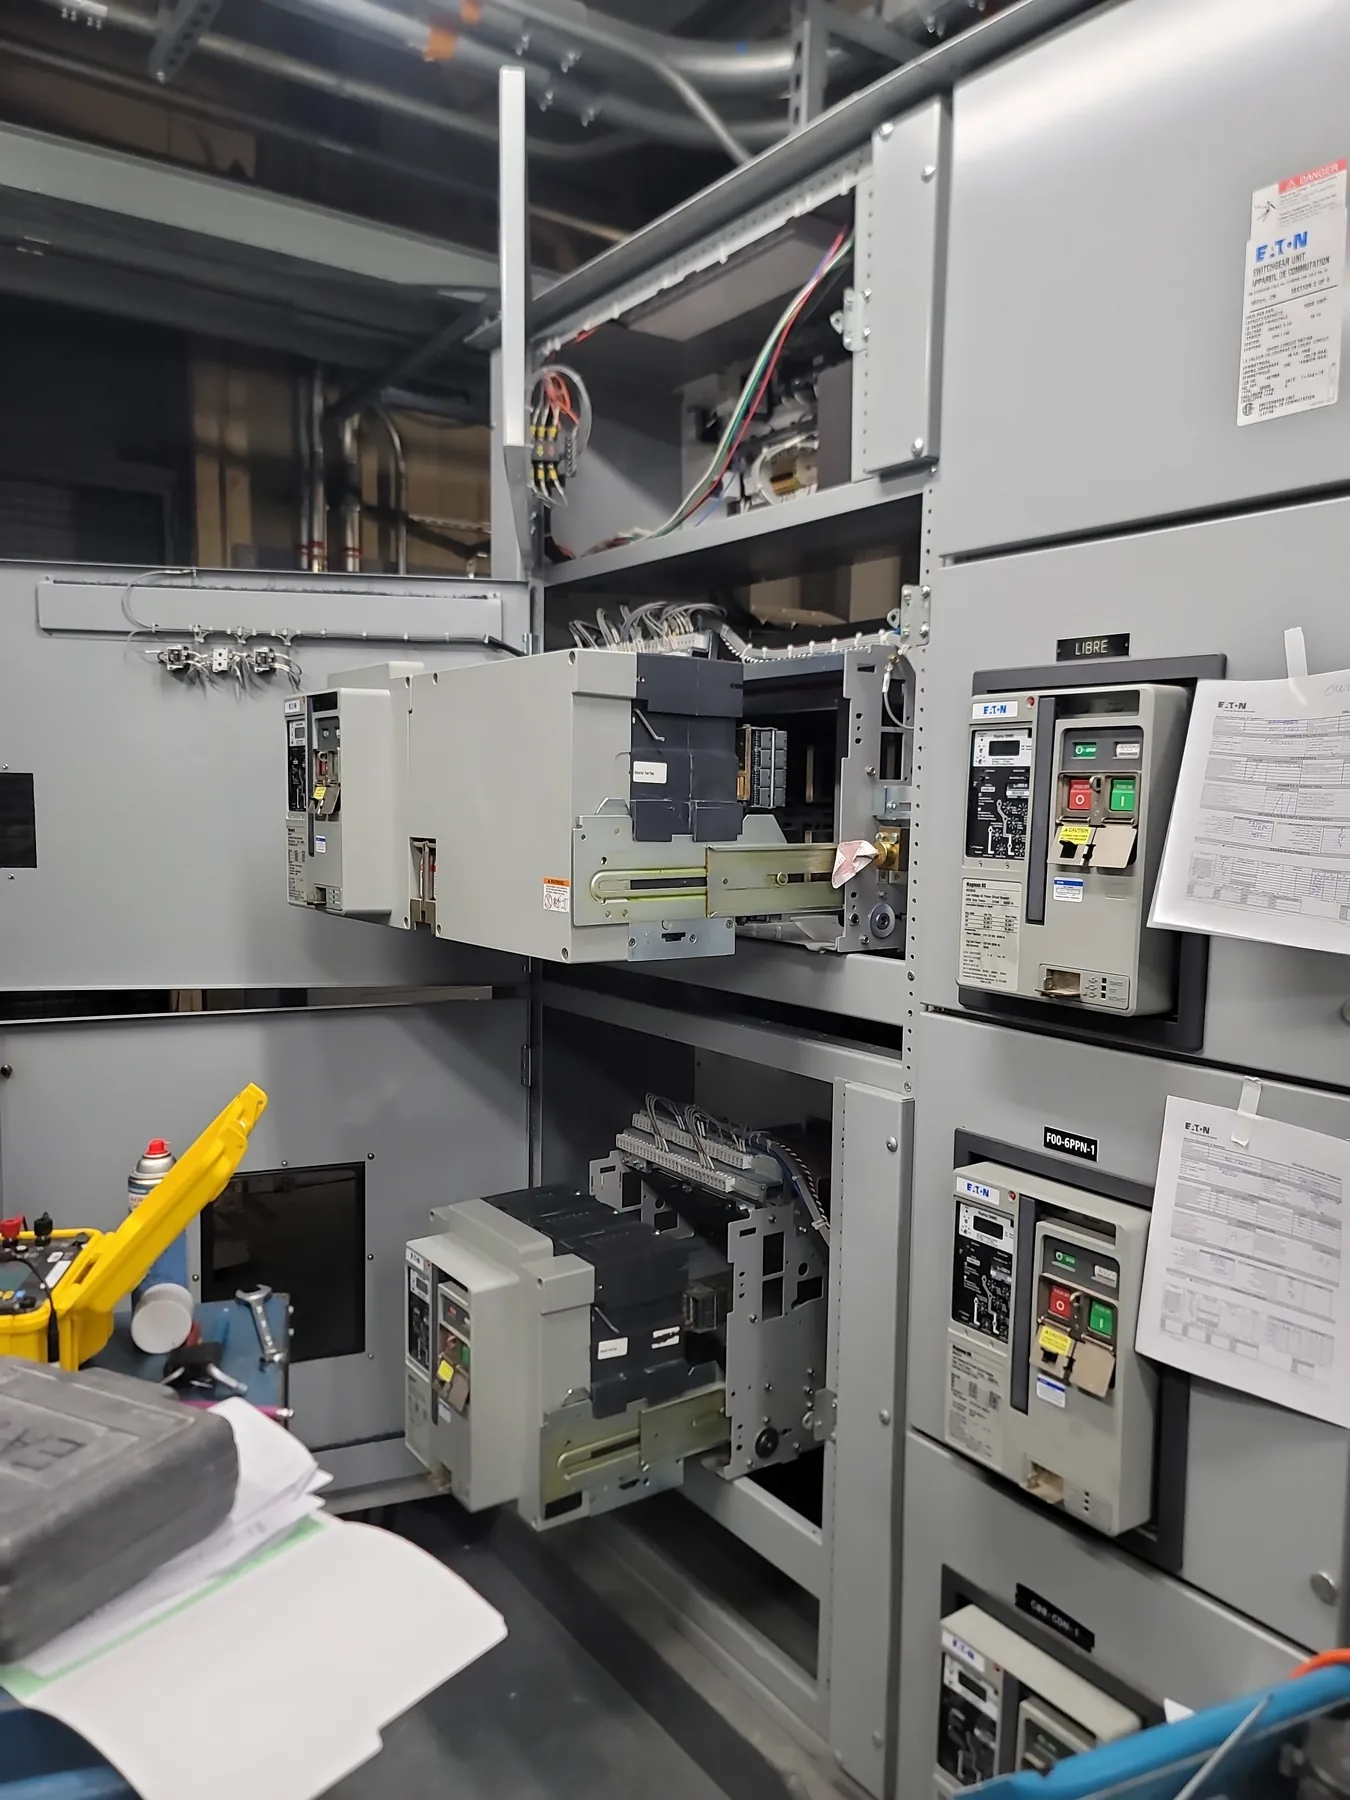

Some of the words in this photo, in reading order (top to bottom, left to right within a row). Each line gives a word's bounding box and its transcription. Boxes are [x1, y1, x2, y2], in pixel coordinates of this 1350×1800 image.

[1299, 163, 1339, 185] DANGER
[1252, 258, 1290, 277] SWITCHGEAR
[1291, 252, 1306, 266] UNIT
[1288, 256, 1330, 277] COMMUTATION
[1075, 639, 1108, 655] LIBRE
[1046, 1132, 1095, 1155] F00-6PPN-1
